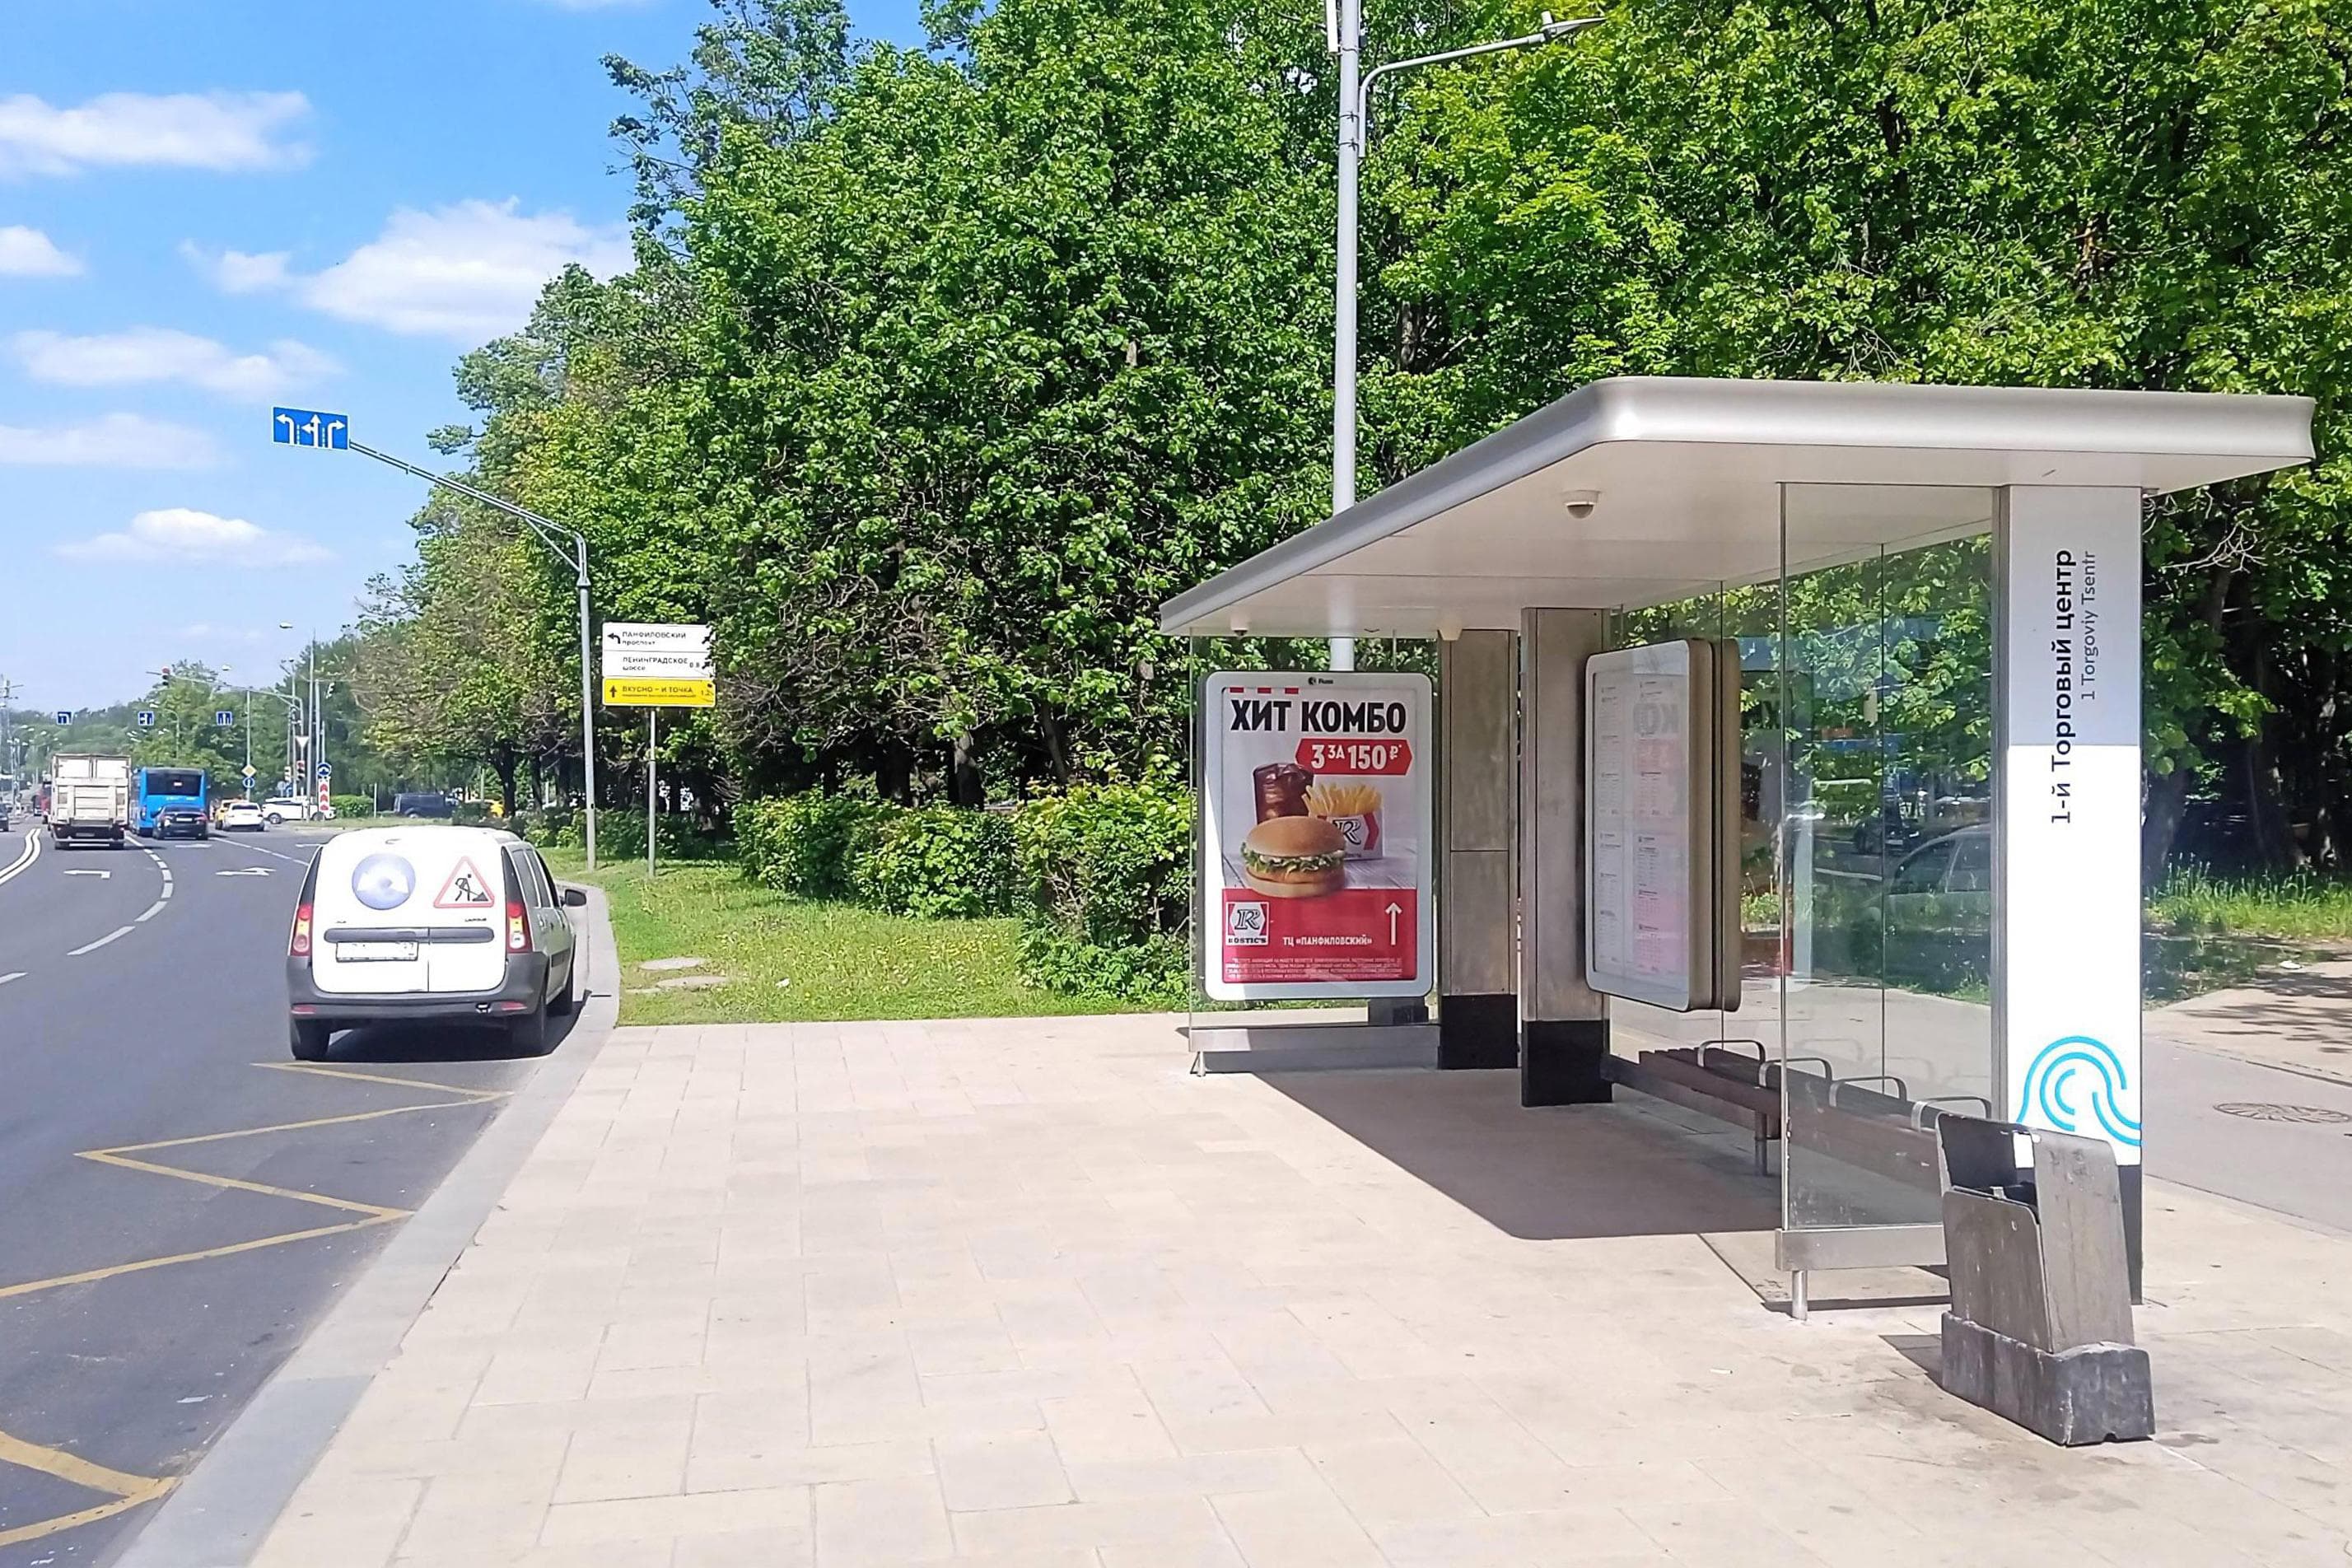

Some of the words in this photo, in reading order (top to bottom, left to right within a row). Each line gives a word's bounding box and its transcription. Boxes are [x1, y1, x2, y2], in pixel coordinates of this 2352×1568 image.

[2055, 548, 2077, 631] центр
[2081, 551, 2097, 607] Tsentr
[2081, 609, 2099, 687] Torgoviy
[2051, 640, 2076, 772] Торговый
[2081, 690, 2096, 700] 1
[1230, 699, 1292, 731] ХИТ
[1300, 701, 1407, 734] КОМБО
[1310, 744, 1325, 769] 3
[1347, 744, 1388, 770] 150
[2051, 782, 2071, 824] 1-й
[1282, 936, 1295, 947] ТЦ
